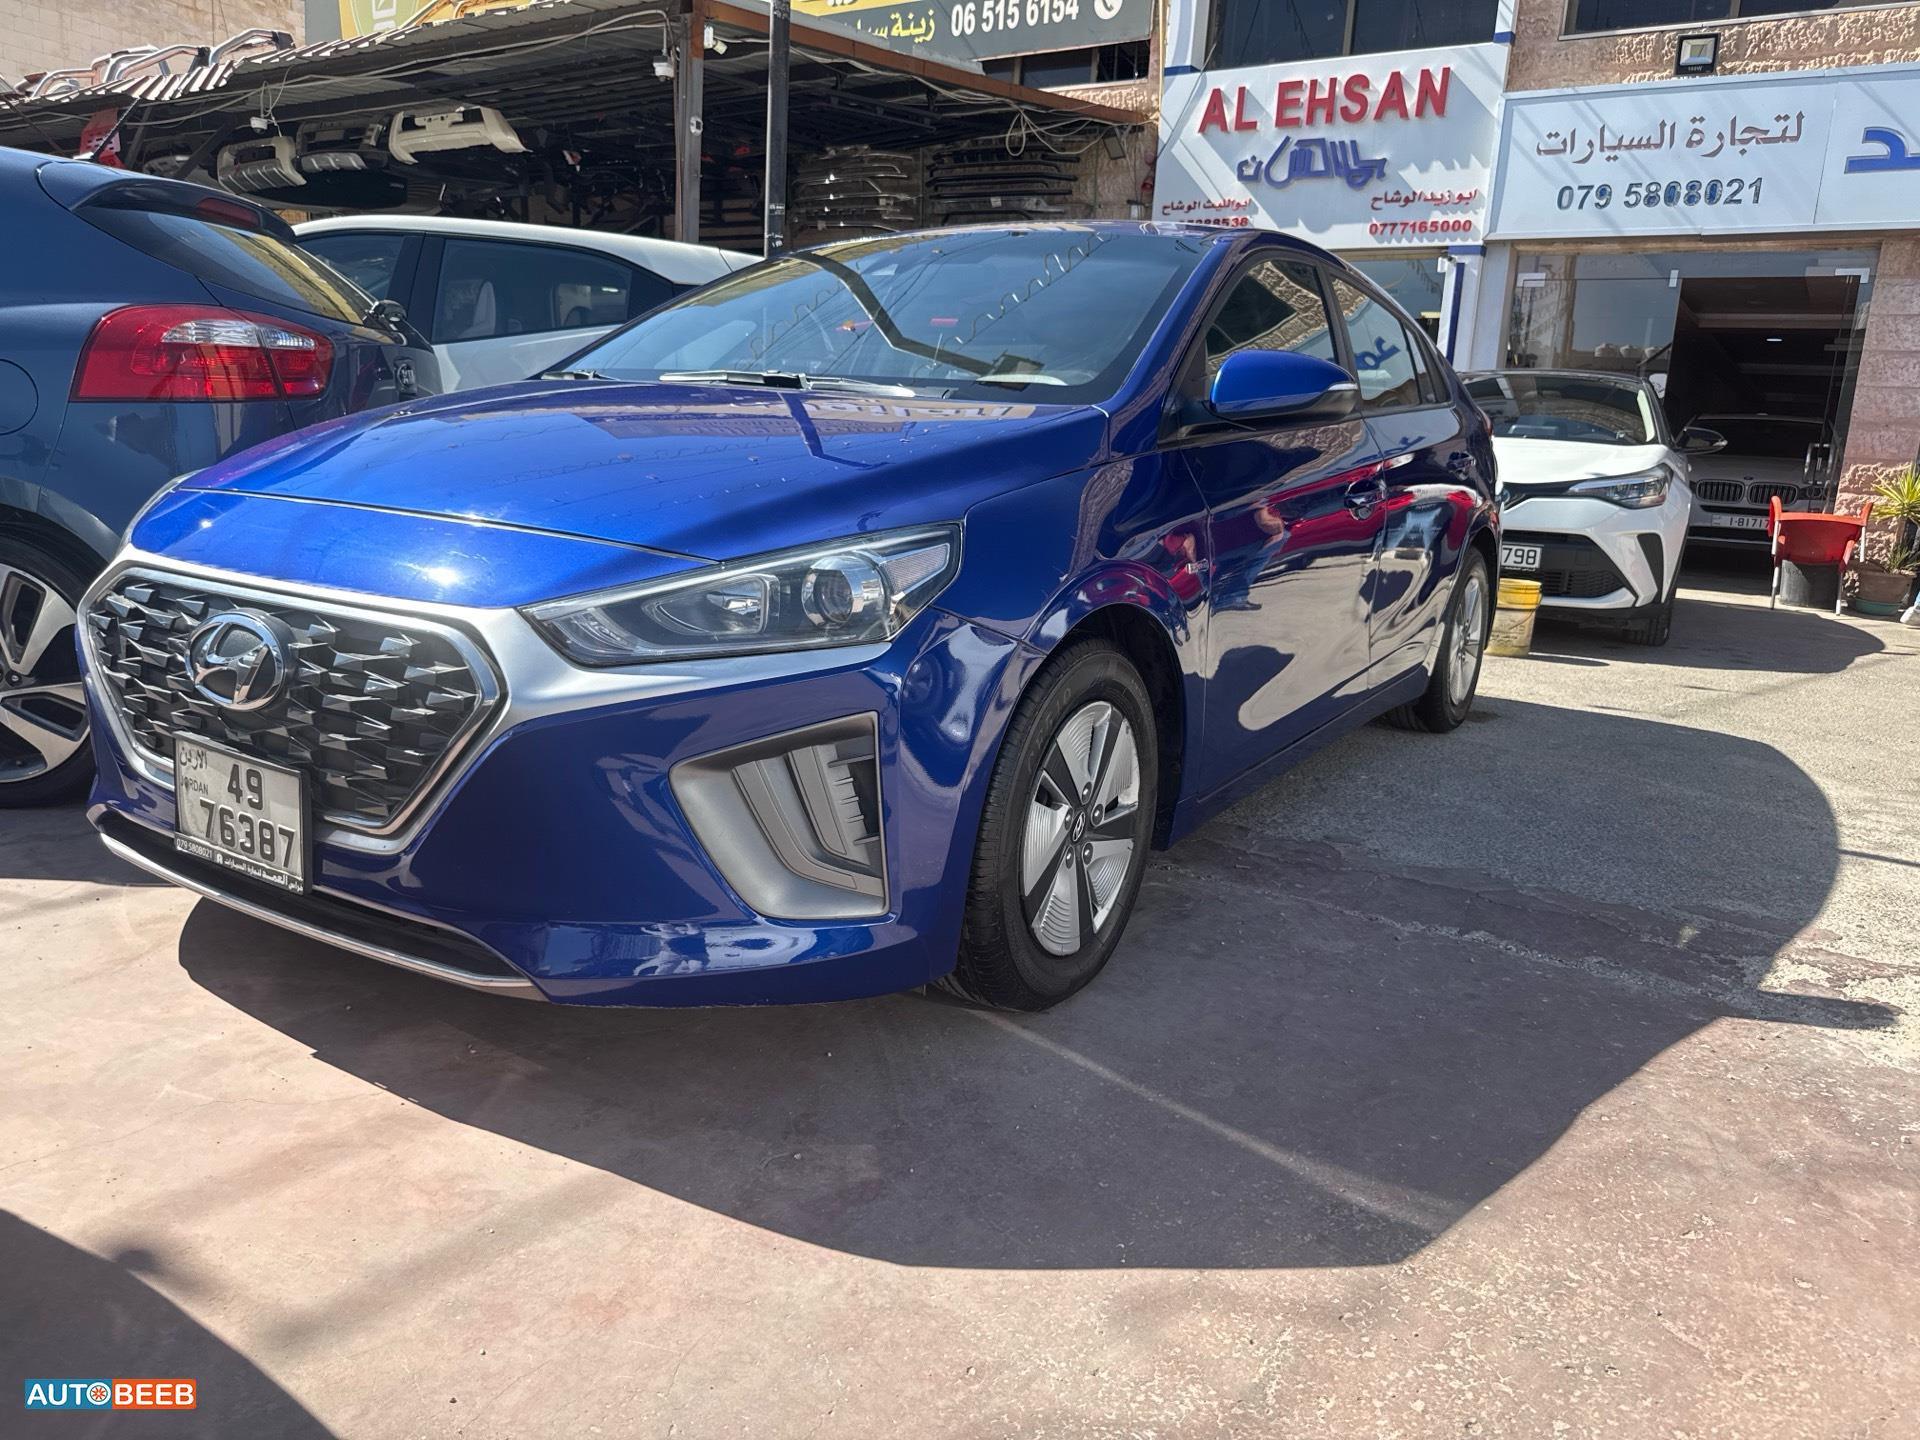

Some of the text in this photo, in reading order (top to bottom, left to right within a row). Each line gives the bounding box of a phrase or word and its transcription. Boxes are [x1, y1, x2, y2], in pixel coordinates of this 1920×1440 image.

[890, 9, 936, 43] زينة
[951, 0, 1080, 37] 06 515 6154
[1198, 67, 1451, 133] AL EHSAN
[1536, 110, 1805, 164] لتجارة السيارات
[1556, 177, 1763, 210] 079 5808021
[1369, 219, 1472, 235] 0777165000
[180, 775, 209, 796] JORDAN
[227, 763, 264, 811] 49
[199, 797, 297, 869] 76387
